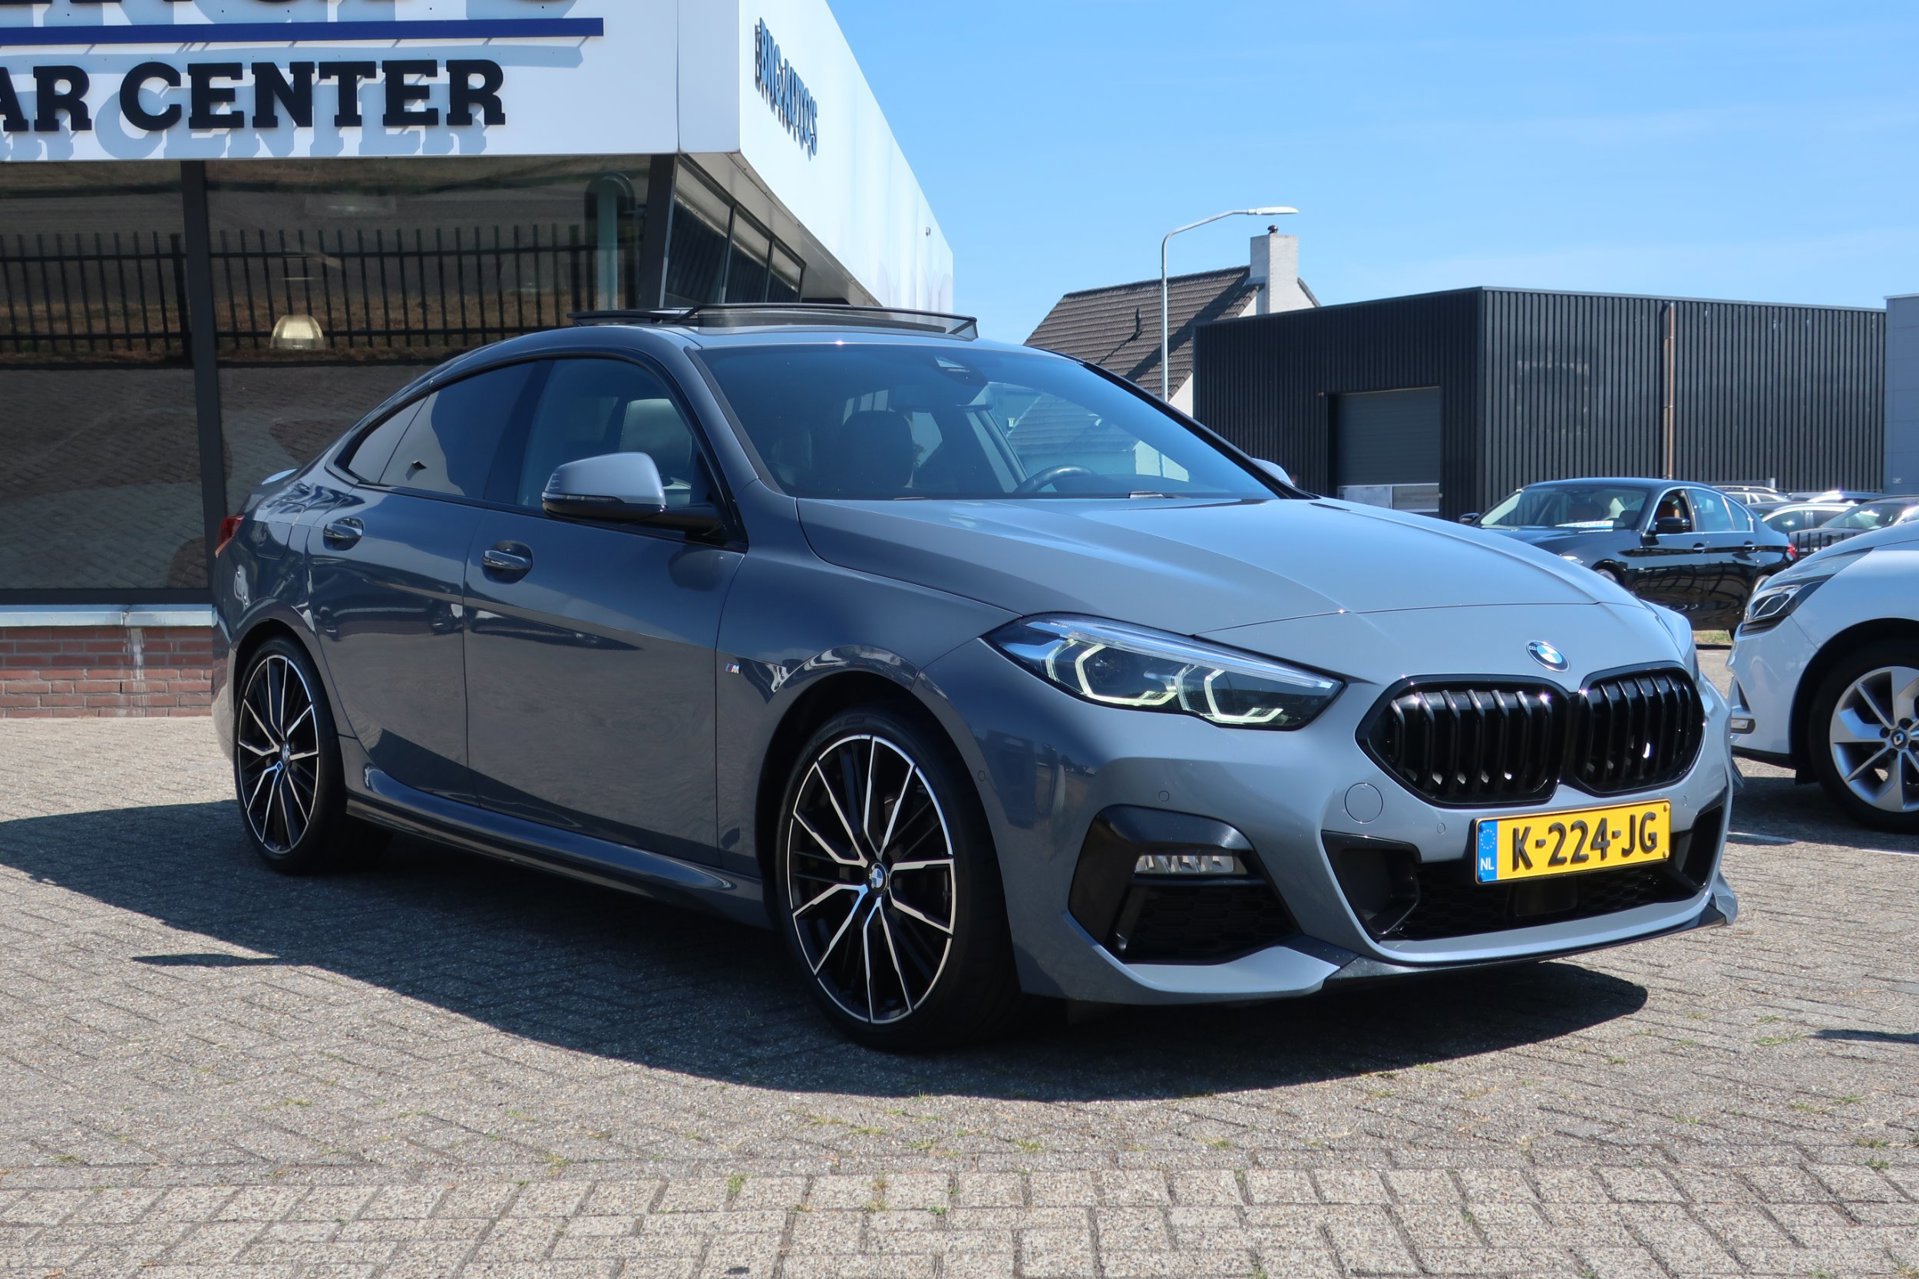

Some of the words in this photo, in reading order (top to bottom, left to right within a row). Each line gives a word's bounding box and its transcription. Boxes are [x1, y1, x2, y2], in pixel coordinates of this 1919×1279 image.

[119, 59, 506, 132] CENTER
[1480, 857, 1495, 871] NL
[1512, 812, 1658, 872] K-224-JG
